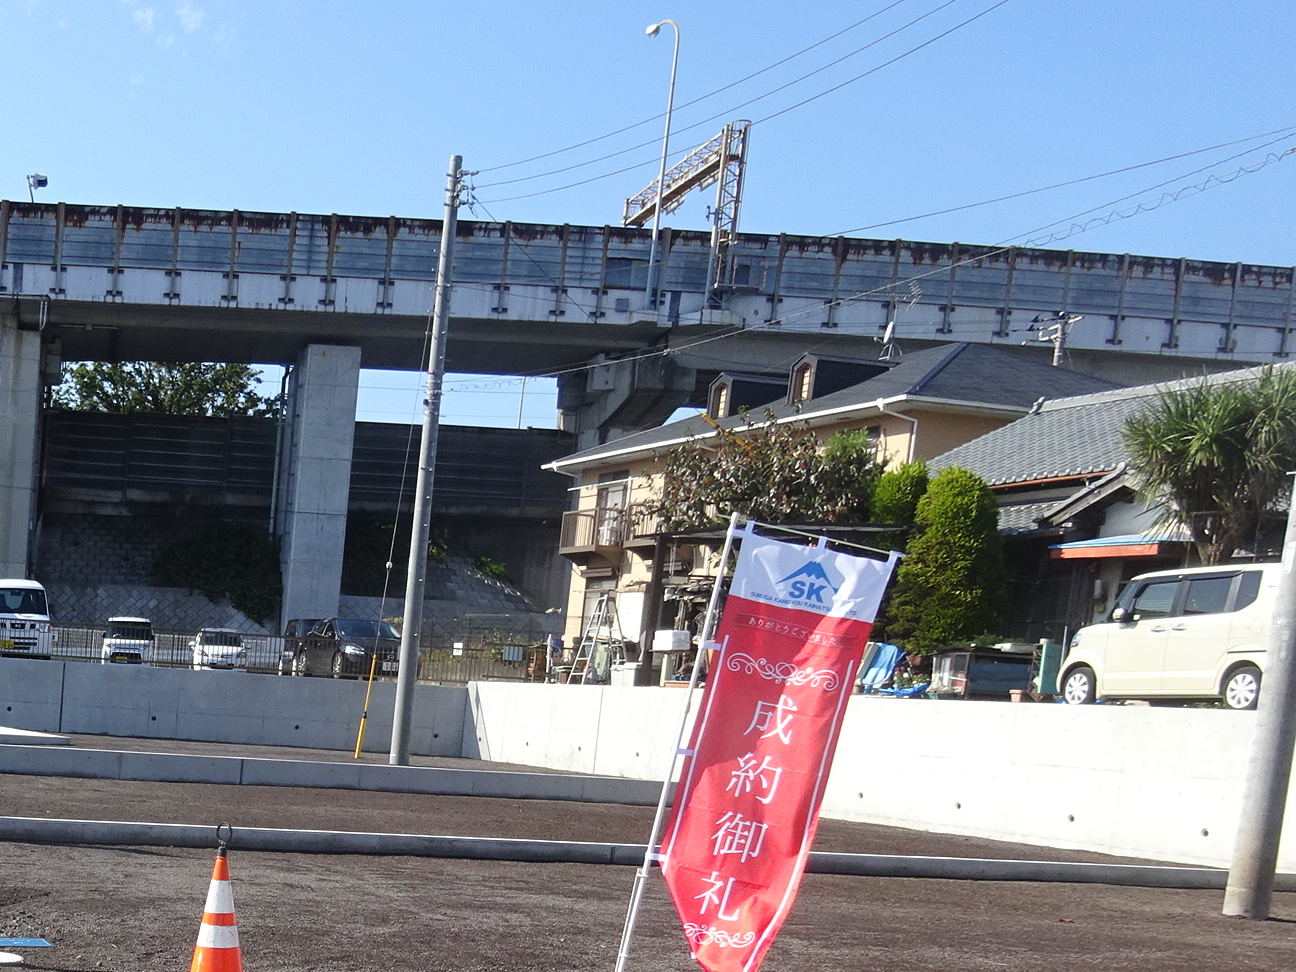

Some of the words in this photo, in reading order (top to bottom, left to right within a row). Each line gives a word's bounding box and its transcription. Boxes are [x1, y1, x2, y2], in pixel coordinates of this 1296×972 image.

[789, 581, 827, 603] SK
[694, 694, 799, 923] 成約御礼
